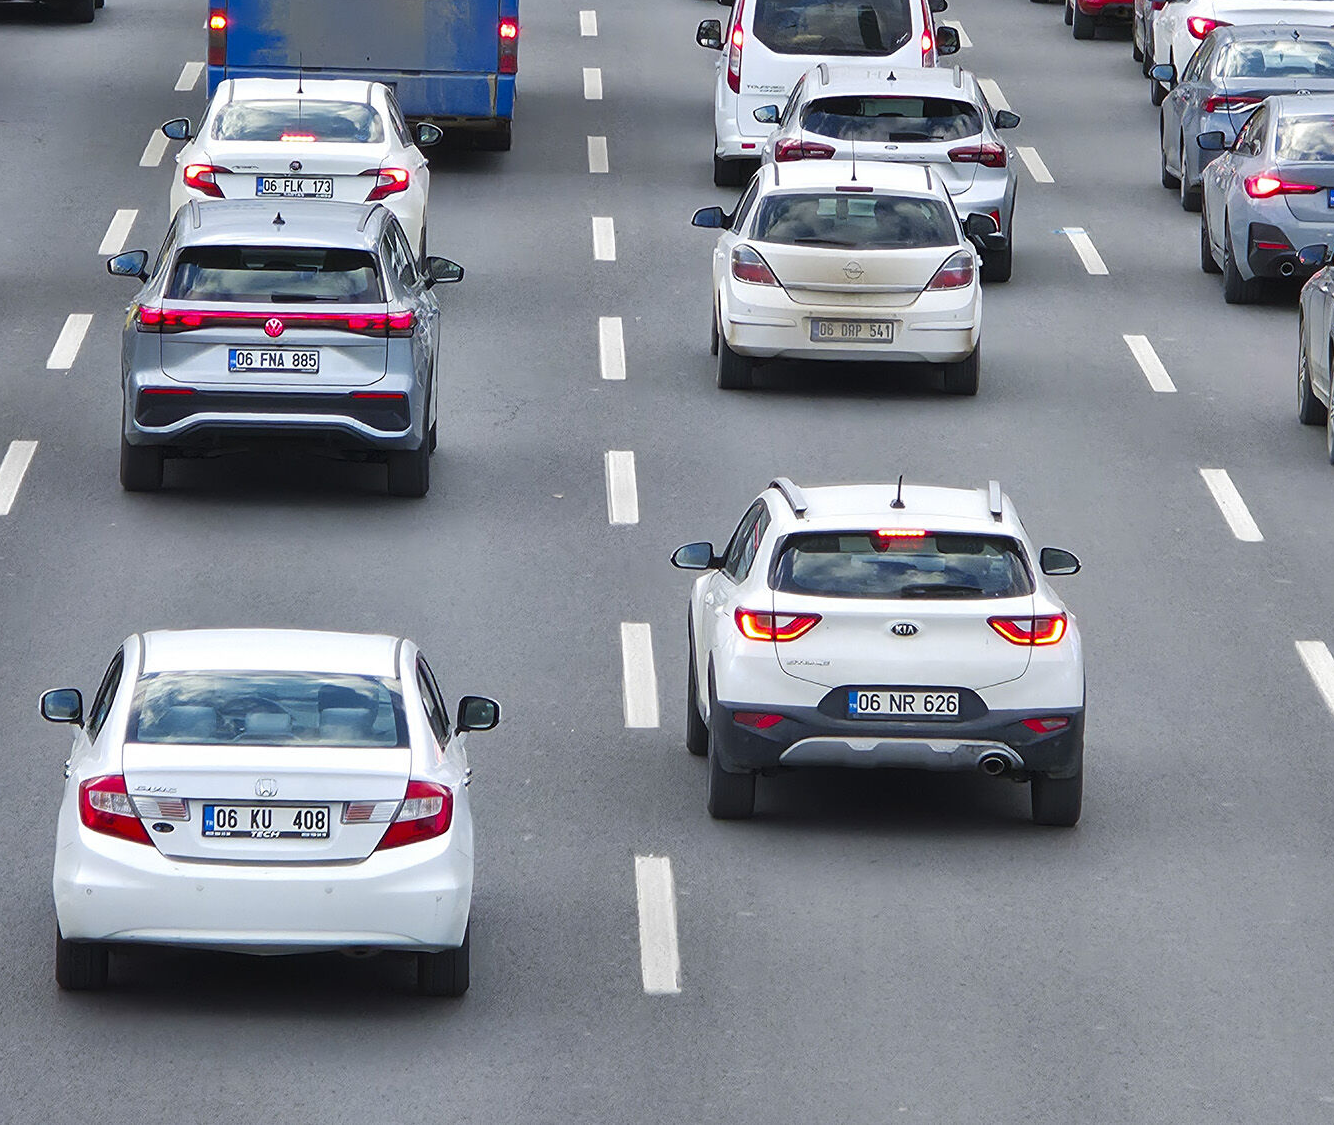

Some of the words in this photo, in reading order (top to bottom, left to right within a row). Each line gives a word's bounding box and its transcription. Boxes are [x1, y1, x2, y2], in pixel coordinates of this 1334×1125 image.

[264, 180, 277, 192] 06
[283, 181, 303, 193] FLK
[312, 181, 331, 193] 173
[869, 325, 890, 338] 541
[236, 352, 253, 366] 06
[260, 353, 284, 368] FNA
[292, 354, 317, 368] 885
[895, 624, 914, 635] KIA
[858, 693, 881, 711] 06
[889, 694, 915, 713] NR
[923, 695, 957, 712] 626
[216, 809, 237, 829] 06
[250, 809, 272, 829] KU
[292, 810, 326, 831] 408
[250, 830, 280, 839] TECH
